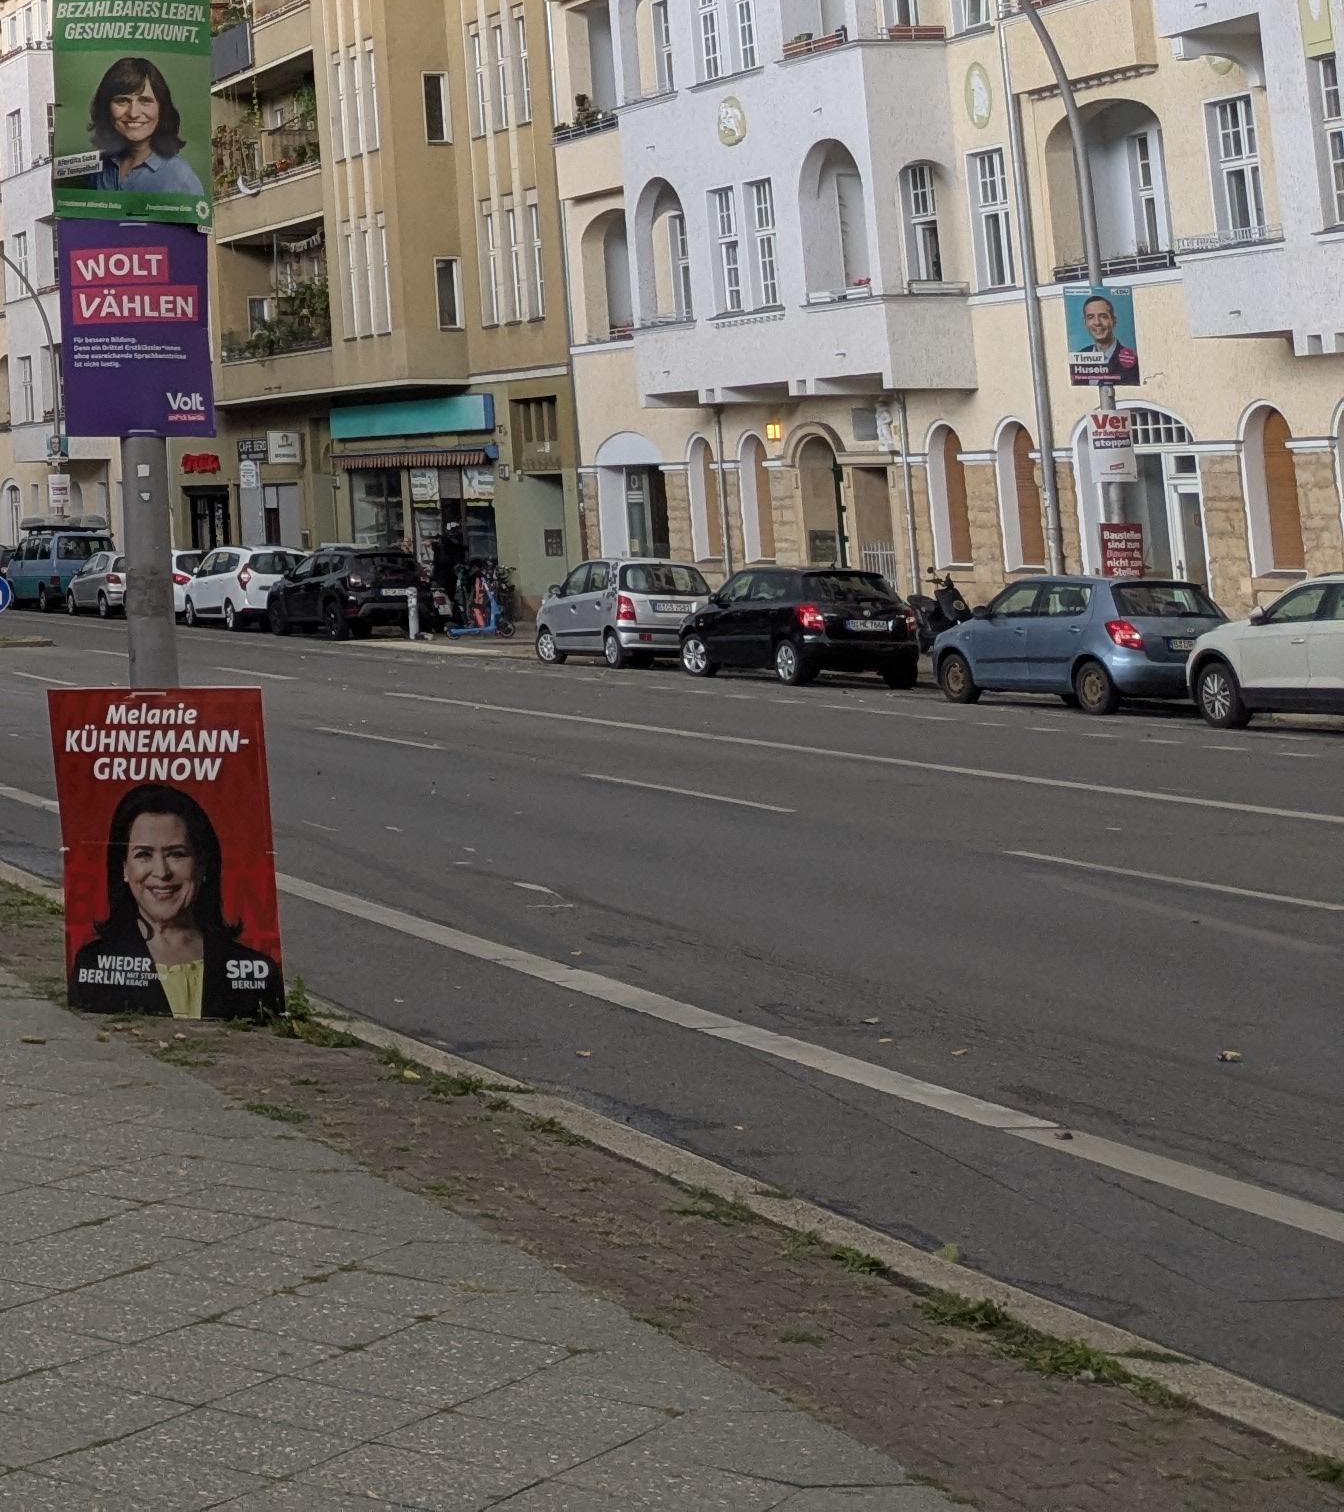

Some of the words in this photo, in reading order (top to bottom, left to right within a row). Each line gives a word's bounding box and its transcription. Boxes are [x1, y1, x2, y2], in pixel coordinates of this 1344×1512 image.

[56, 1, 160, 19] BEZAHLBARES
[162, 3, 206, 22] LEBEN.
[64, 22, 133, 39] GESUNDE
[134, 23, 199, 43] ZUKUNFT.
[77, 253, 163, 281] WOLT
[79, 287, 193, 319] VÄHLEN
[1074, 354, 1103, 363] Timur
[1074, 365, 1109, 374] Husein
[166, 392, 205, 410] Volt
[1091, 414, 1128, 430] Ver
[1108, 539, 1126, 548] sind
[1107, 558, 1129, 567] nicht
[106, 703, 198, 725] Melanie
[65, 725, 249, 753] KÜHNEMANN-
[93, 757, 222, 781] GRUNOW
[97, 955, 152, 972] WIEDER
[226, 959, 269, 979] SPD
[78, 968, 126, 986] BERLIN
[231, 979, 265, 989] BERLIN
